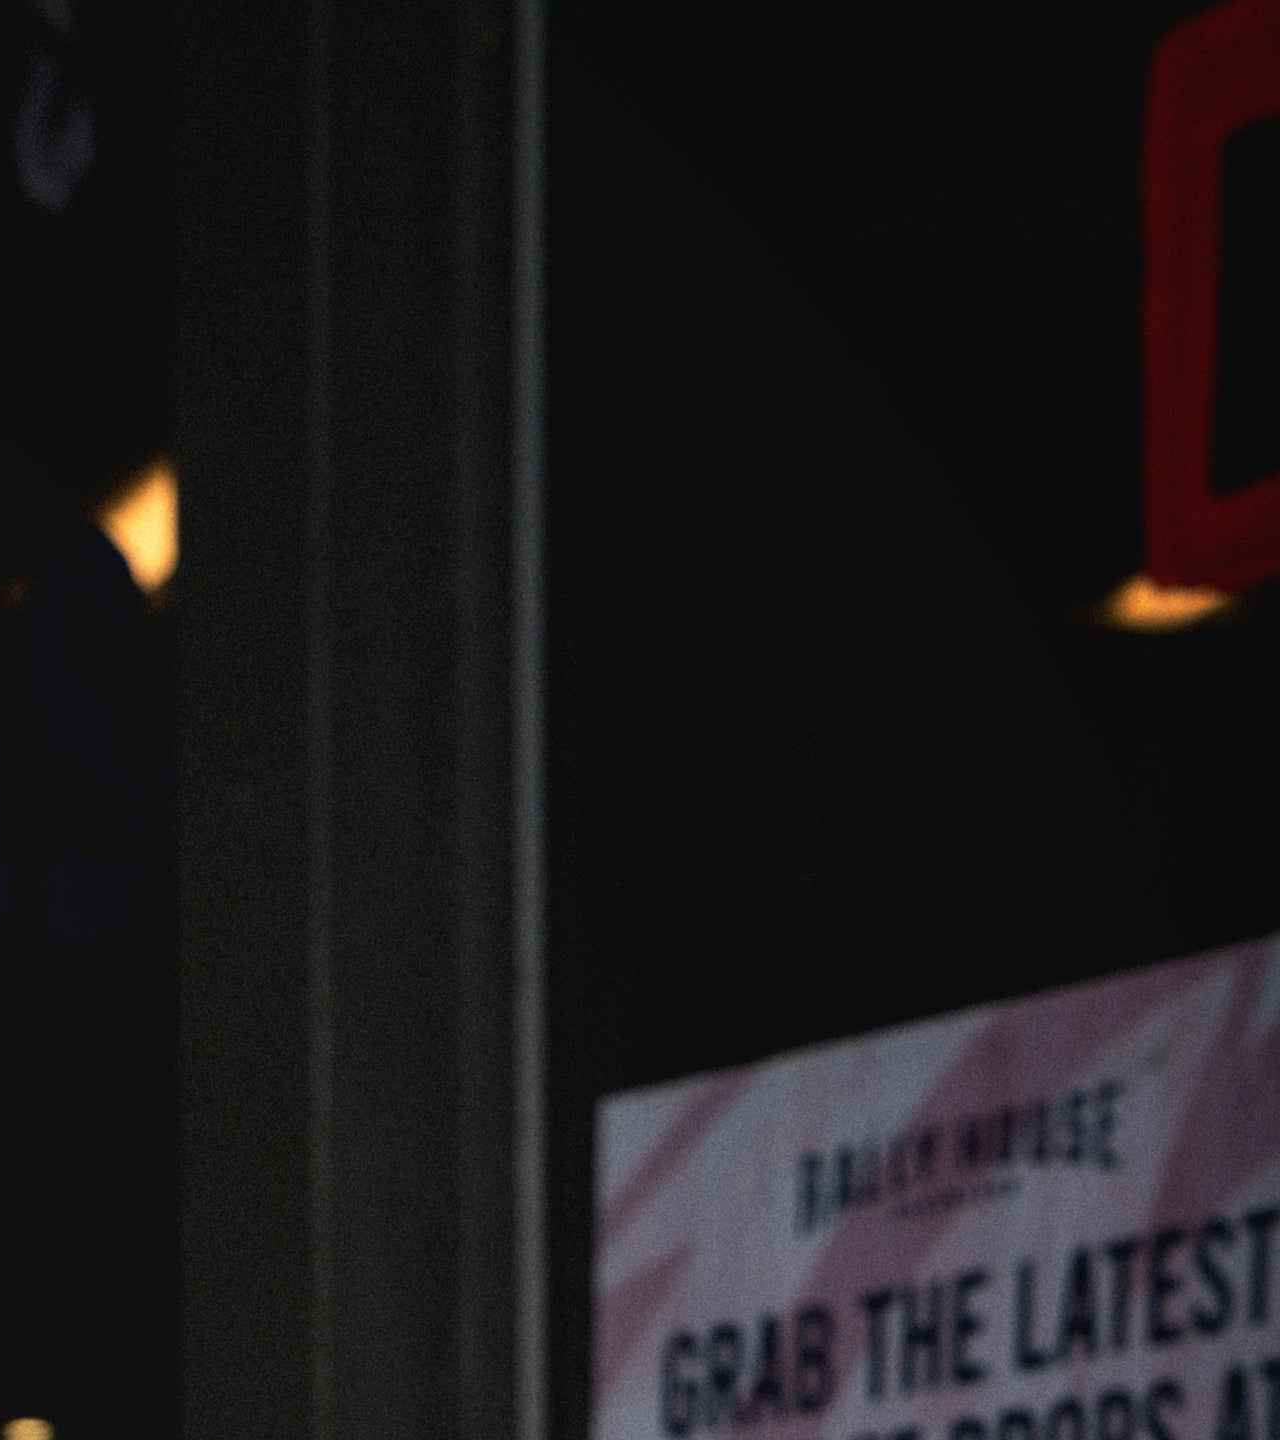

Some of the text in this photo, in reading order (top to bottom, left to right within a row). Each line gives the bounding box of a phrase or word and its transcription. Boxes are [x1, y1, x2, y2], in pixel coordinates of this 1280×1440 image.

[662, 1208, 1279, 1438] GRAB THE LATEST
